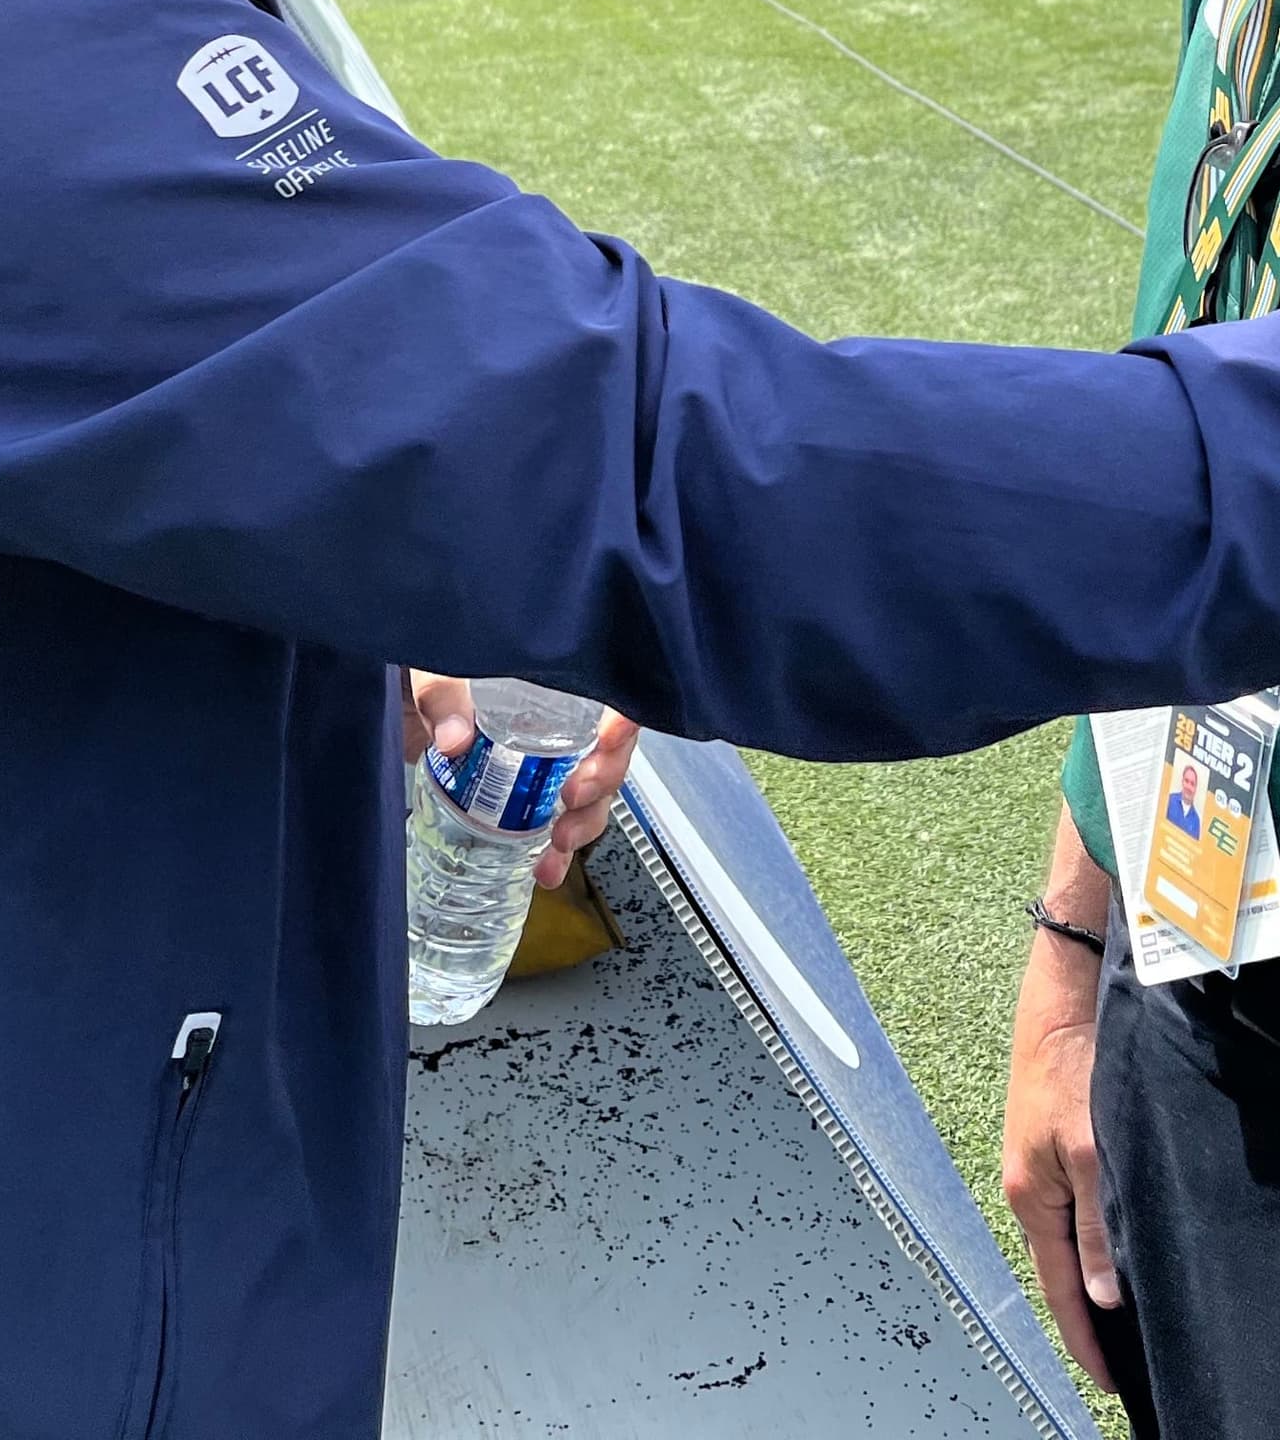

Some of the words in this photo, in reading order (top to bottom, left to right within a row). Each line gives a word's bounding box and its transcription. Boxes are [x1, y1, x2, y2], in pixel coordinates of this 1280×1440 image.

[203, 55, 276, 118] LCF
[1196, 723, 1235, 766] TIER
[1234, 752, 1254, 793] 2
